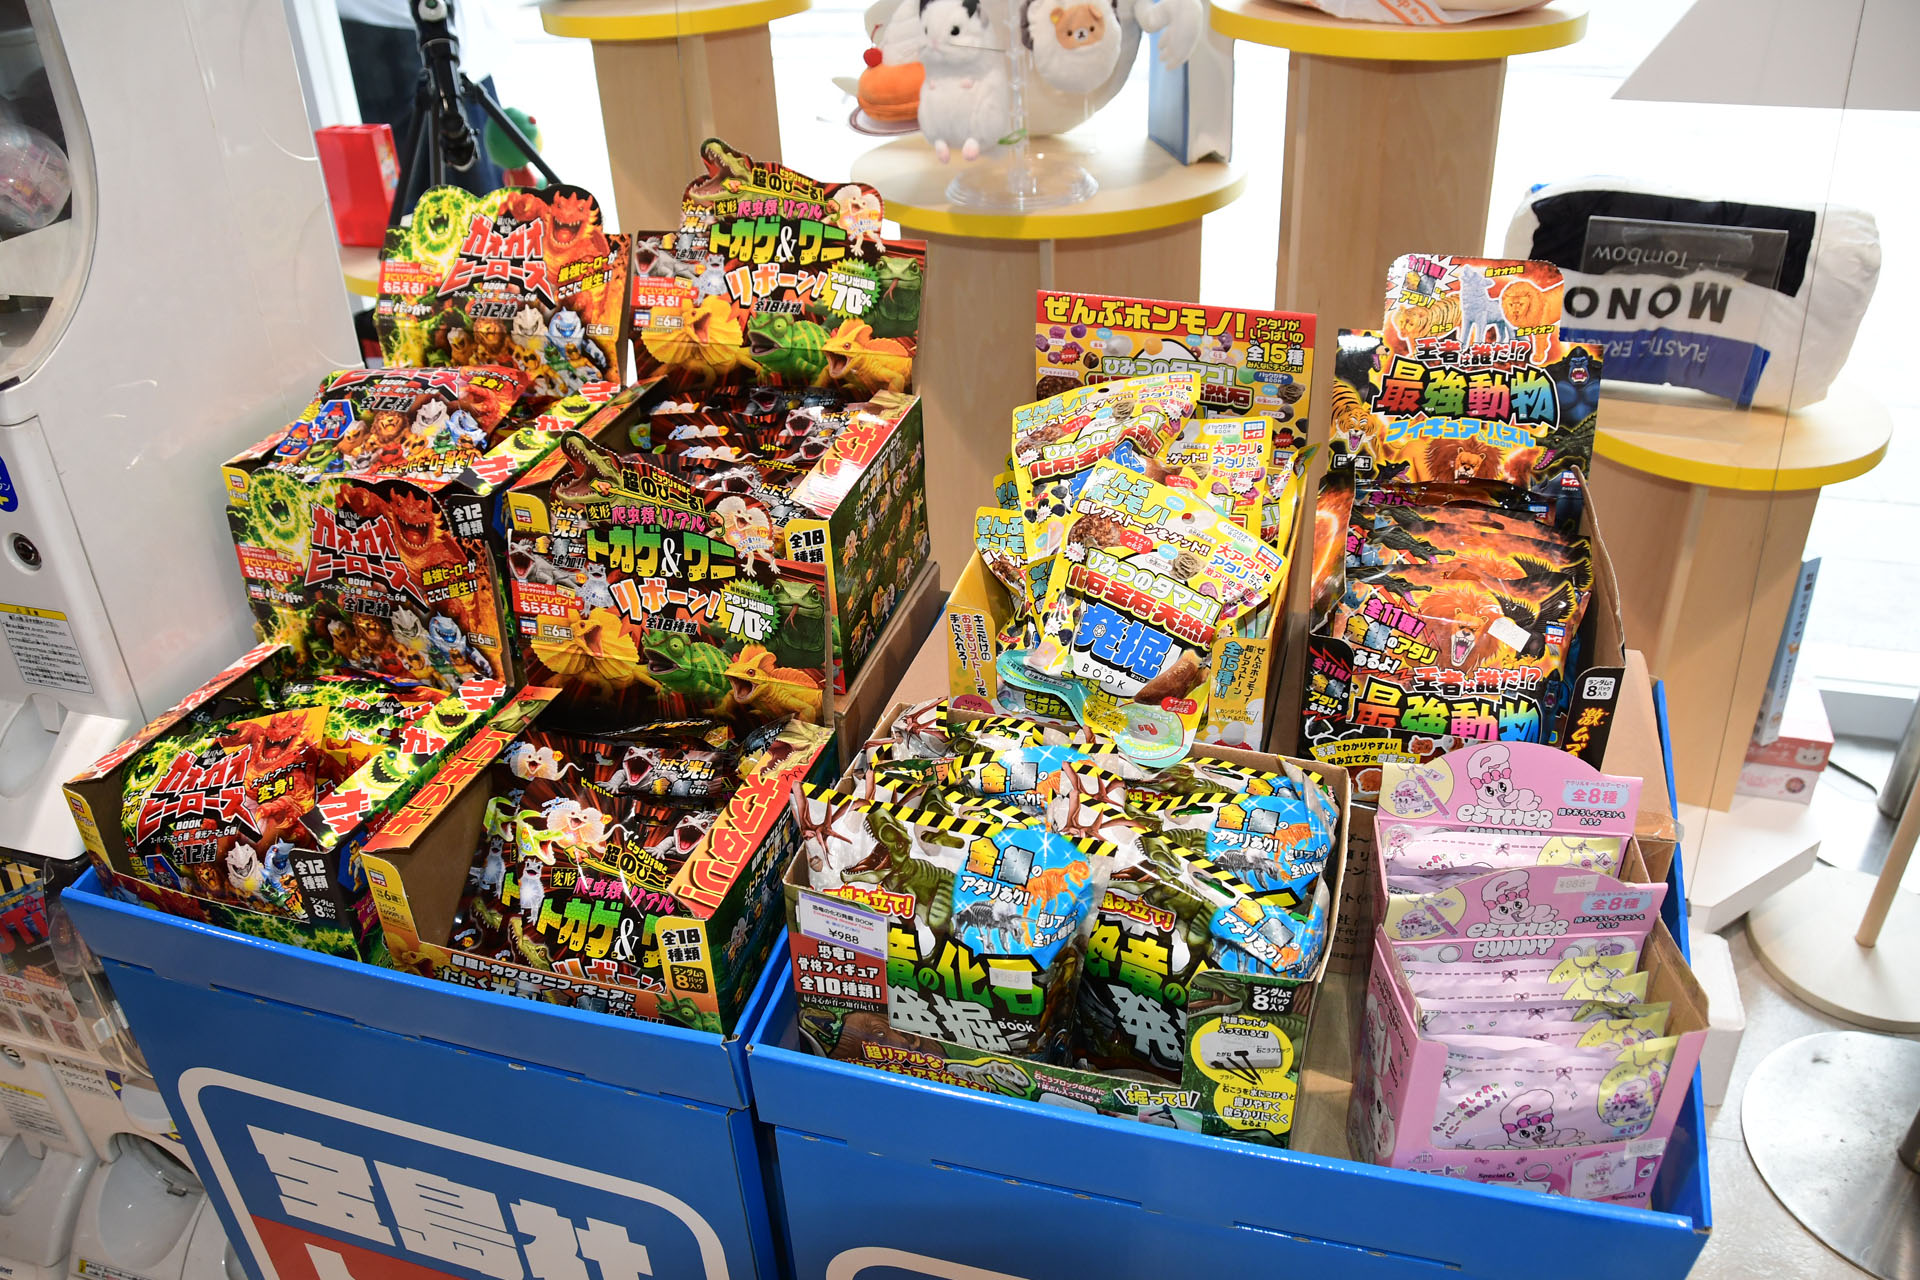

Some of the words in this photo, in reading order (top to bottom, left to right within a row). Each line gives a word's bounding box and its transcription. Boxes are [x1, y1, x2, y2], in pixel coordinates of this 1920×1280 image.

[783, 200, 822, 219] リアル
[1592, 245, 1689, 268] Tombow
[557, 250, 617, 283] 最強ヒーローが
[383, 282, 424, 294] もらえる!
[437, 257, 555, 304] ヒーローズ
[558, 270, 612, 299] ここに誕生!!
[724, 263, 828, 306] リボーン!
[638, 296, 680, 306] もらえる!
[754, 300, 801, 314] 全18種類
[831, 283, 872, 316] 70%
[1399, 291, 1435, 309] アタリ!
[1563, 280, 1732, 325] MONO
[469, 303, 518, 318] 全12種
[1044, 295, 1247, 338] ぜんぶホンモノ!
[1255, 317, 1300, 329] アタリが
[1431, 323, 1453, 334] 金トラ
[1516, 325, 1554, 336] 金ライオン
[1249, 328, 1304, 343] いっぱいの
[1247, 342, 1304, 365] 全15種
[1416, 337, 1531, 367] 王者は誰だ!?
[1379, 361, 1555, 425] 最強動物
[360, 394, 415, 412] 全12種
[1244, 430, 1264, 438] トイズ
[1385, 418, 1480, 442] フィギュア
[1487, 423, 1536, 448] パズル
[1213, 443, 1262, 456] 大アタリ&
[1213, 456, 1245, 469] アタリ
[452, 503, 483, 522] 全12
[589, 503, 611, 520] 変形
[1085, 485, 1171, 524] ホンモノ!
[458, 520, 484, 537] 種類
[611, 506, 656, 525] 爬虫類
[660, 507, 705, 532] リアル
[976, 516, 1024, 535] ぜんぶ
[1077, 500, 1211, 556] 超レアストーンをゲット!!
[788, 529, 825, 549] 全18
[568, 546, 586, 554] ver.
[793, 549, 824, 563] 種類
[553, 555, 586, 568] 追加!!
[1210, 555, 1249, 579] アタリ
[1216, 543, 1271, 582] 大アタリ&
[245, 566, 289, 582] もらえる!
[304, 549, 429, 606] ヒーローズ
[348, 577, 372, 588] BOOK
[422, 560, 476, 586] 最強ヒーローが
[427, 580, 478, 602] ここに誕生!!
[1086, 550, 1220, 625] ひみつのタマゴ!
[344, 598, 391, 616] 全12種
[521, 600, 565, 616] もらえる!
[610, 577, 721, 622] リボーン!
[645, 616, 697, 635] 全18種類
[729, 604, 773, 641] 70%
[1365, 597, 1426, 638] 全11種!
[949, 614, 967, 669] 手に入れろ!
[973, 614, 992, 661] キミだけの
[1074, 604, 1173, 679] 発掘
[961, 614, 987, 696] おまもりストーンを
[1354, 650, 1400, 675] あるよ!
[1082, 663, 1129, 690] BOOK
[1214, 641, 1244, 698] 全15種!!
[1234, 645, 1254, 695] 超レアストーン
[1244, 647, 1266, 704] ぜんぶホンモノ!
[1413, 666, 1542, 697] 王者は誰だ!?
[1586, 686, 1597, 697] 8
[1309, 703, 1334, 716] あるよ!
[1354, 681, 1541, 744] 最強動物
[251, 762, 306, 788] スーパーアーマーで
[380, 730, 517, 836] ギラギラ!
[257, 776, 294, 804] 変身!
[689, 787, 708, 796] ver.
[1572, 788, 1618, 804] 全8種
[136, 786, 263, 846] ヒーローズ
[1558, 808, 1625, 819] 描きおろしイラストも
[1580, 818, 1601, 826] あるよ
[177, 819, 202, 830] BOOK
[1212, 831, 1280, 853] アタリあり!
[174, 841, 218, 865] 全12種
[295, 859, 326, 875] 全12
[302, 875, 329, 890] 種類
[552, 871, 577, 886] 変形
[630, 886, 675, 915] リアル
[960, 876, 1030, 907] アタリあり!
[1591, 897, 1641, 911] 全8種
[855, 918, 874, 927] BOOK
[661, 928, 701, 947] 全18
[829, 928, 859, 944] ¥988
[1218, 911, 1282, 963] アタリあり!
[667, 947, 701, 963] 種類
[819, 945, 855, 960] 恐竜の
[1474, 938, 1555, 958] BUNNY
[798, 957, 878, 978] 骨格フィギュア
[675, 975, 688, 989] 8
[800, 976, 880, 998] 全10種類!
[607, 1000, 635, 1012] ver.
[1252, 995, 1269, 1011] 8
[1269, 1003, 1285, 1011] 入り
[998, 1020, 1037, 1034] BOOK
[1218, 1026, 1269, 1038] 入っているよ!
[863, 1044, 943, 1070] 超リアルな
[1127, 1089, 1187, 1107] 掘って!
[1223, 1085, 1296, 1100] 石こうを水につけると
[1233, 1097, 1281, 1112] 掘りやすく
[1223, 1107, 1289, 1124] 散らかりにくく
[1241, 1120, 1267, 1128] なるよ!
